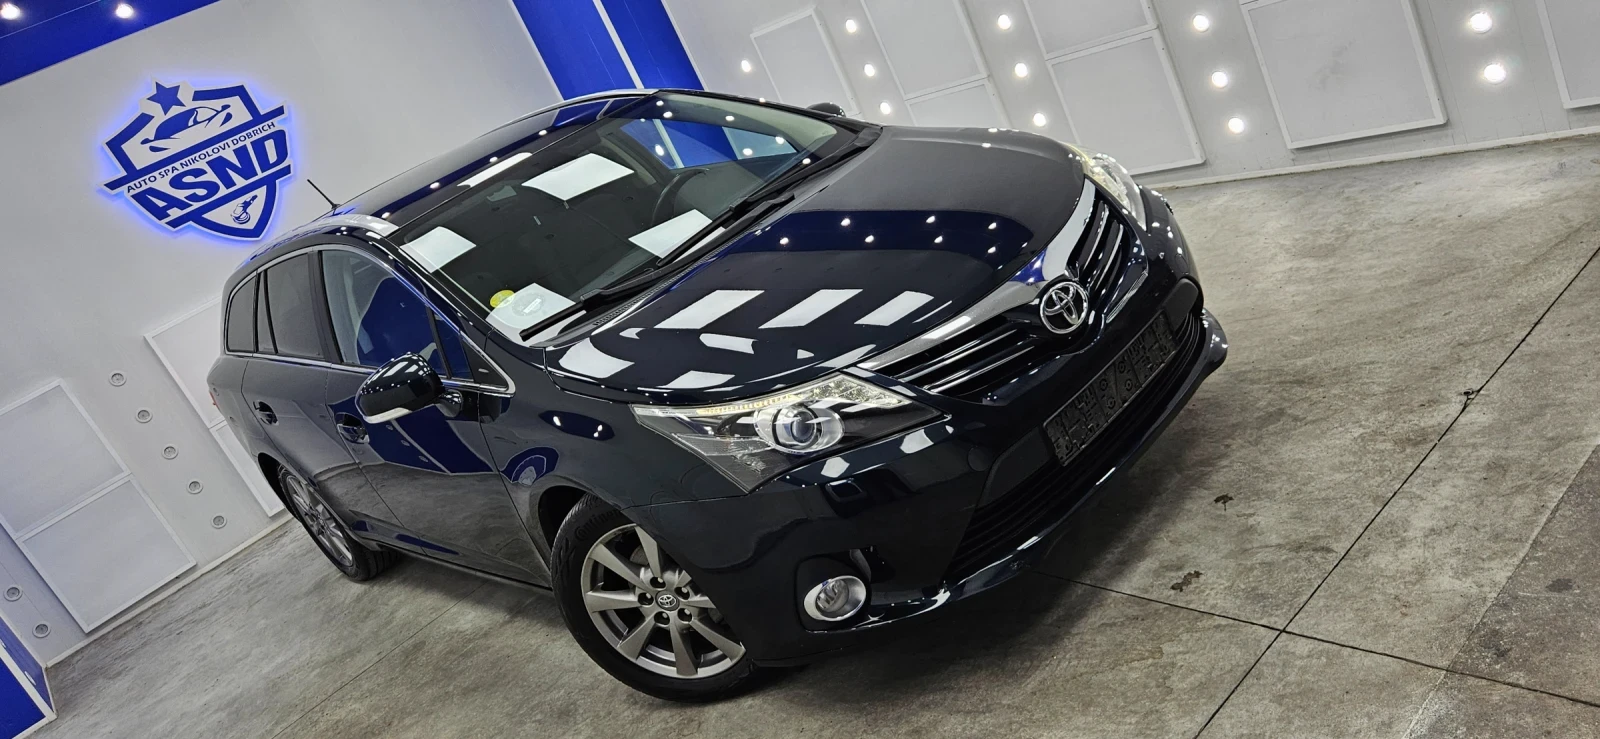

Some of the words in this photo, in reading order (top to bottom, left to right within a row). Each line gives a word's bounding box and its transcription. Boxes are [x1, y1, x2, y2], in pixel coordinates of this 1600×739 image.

[127, 175, 157, 193] AUTO
[159, 166, 179, 179] SPA
[180, 140, 231, 169] NIKOLOVI
[231, 121, 276, 146] DOBRICH
[130, 129, 288, 221] ASND
